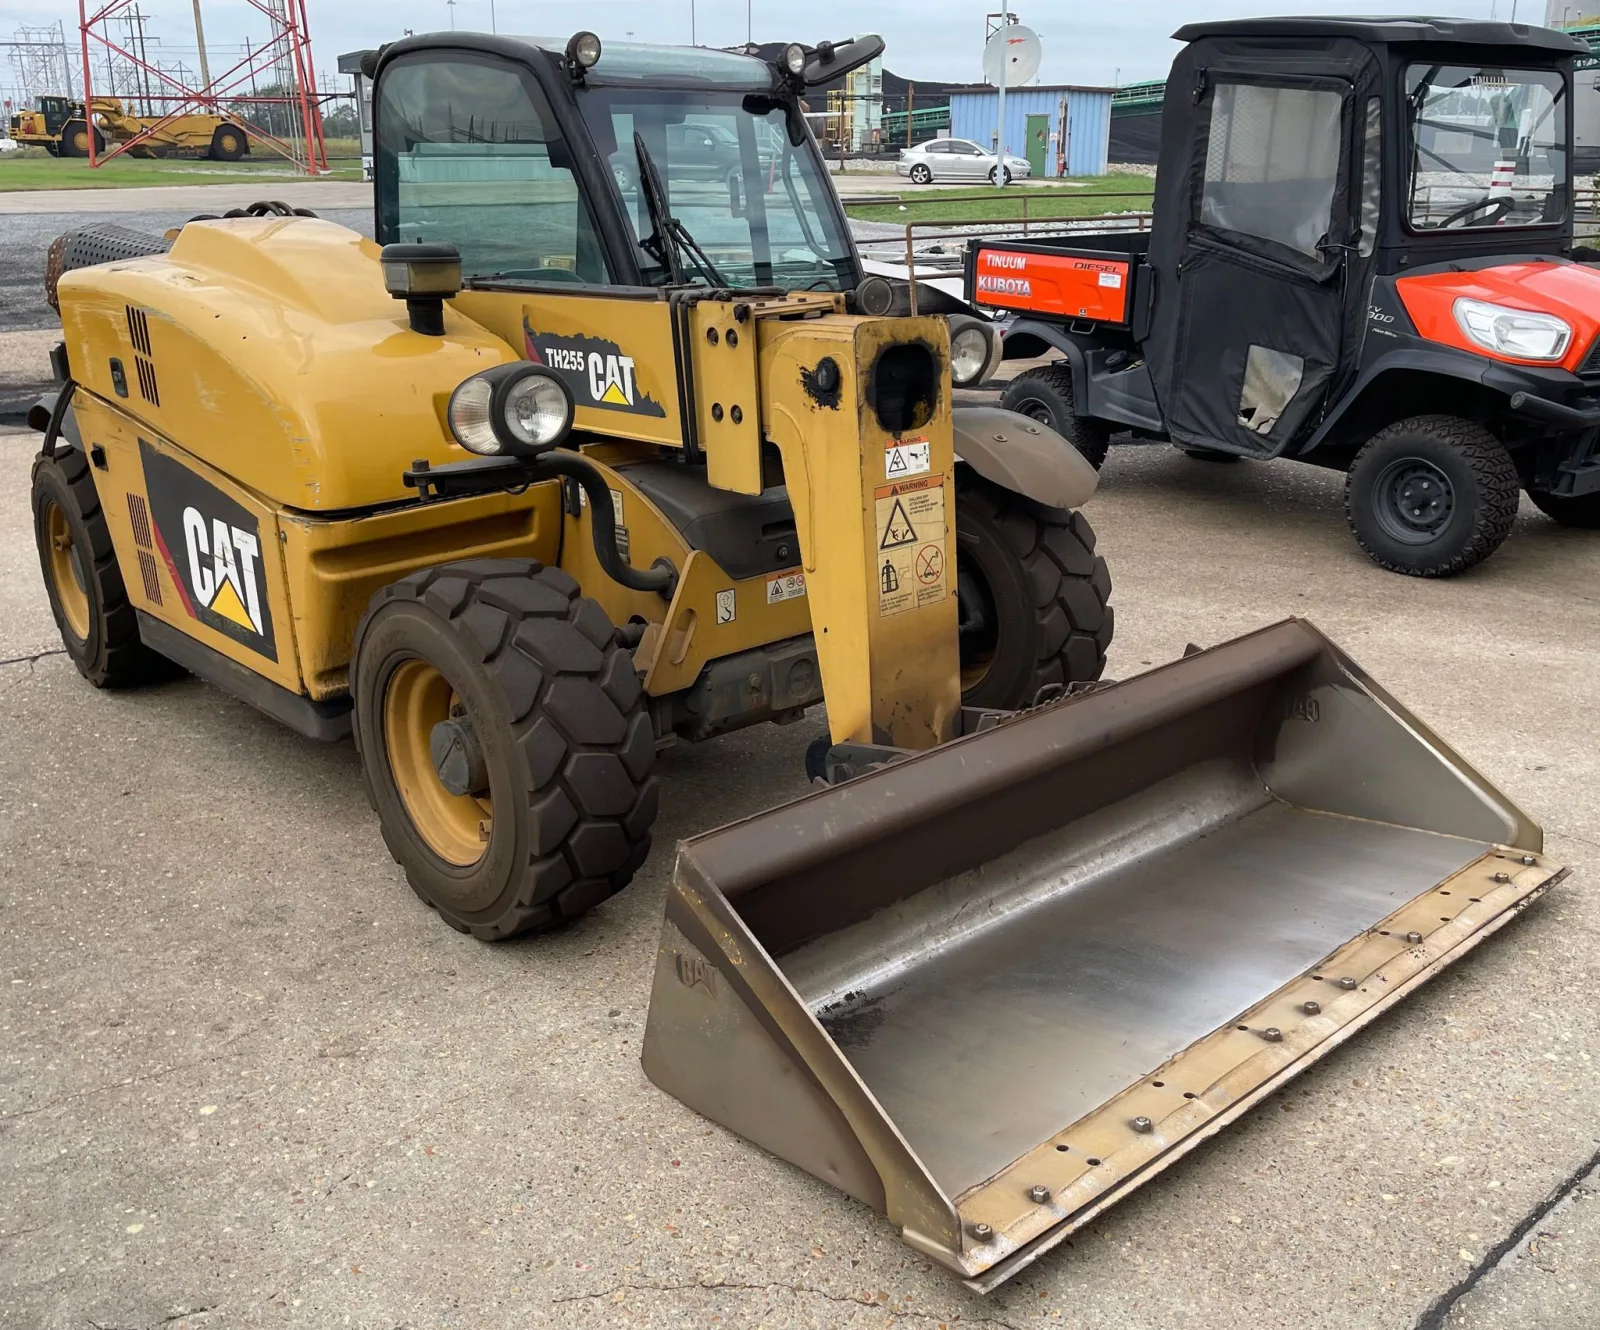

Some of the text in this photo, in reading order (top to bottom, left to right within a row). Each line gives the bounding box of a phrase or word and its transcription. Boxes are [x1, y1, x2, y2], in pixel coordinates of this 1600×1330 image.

[986, 254, 1026, 269] TINUUM
[1074, 262, 1120, 273] DIESEL
[978, 276, 1032, 296] KUBOTA
[545, 348, 635, 406] TH255 CAT
[899, 480, 929, 492] WARNING
[183, 506, 264, 637] CAT
